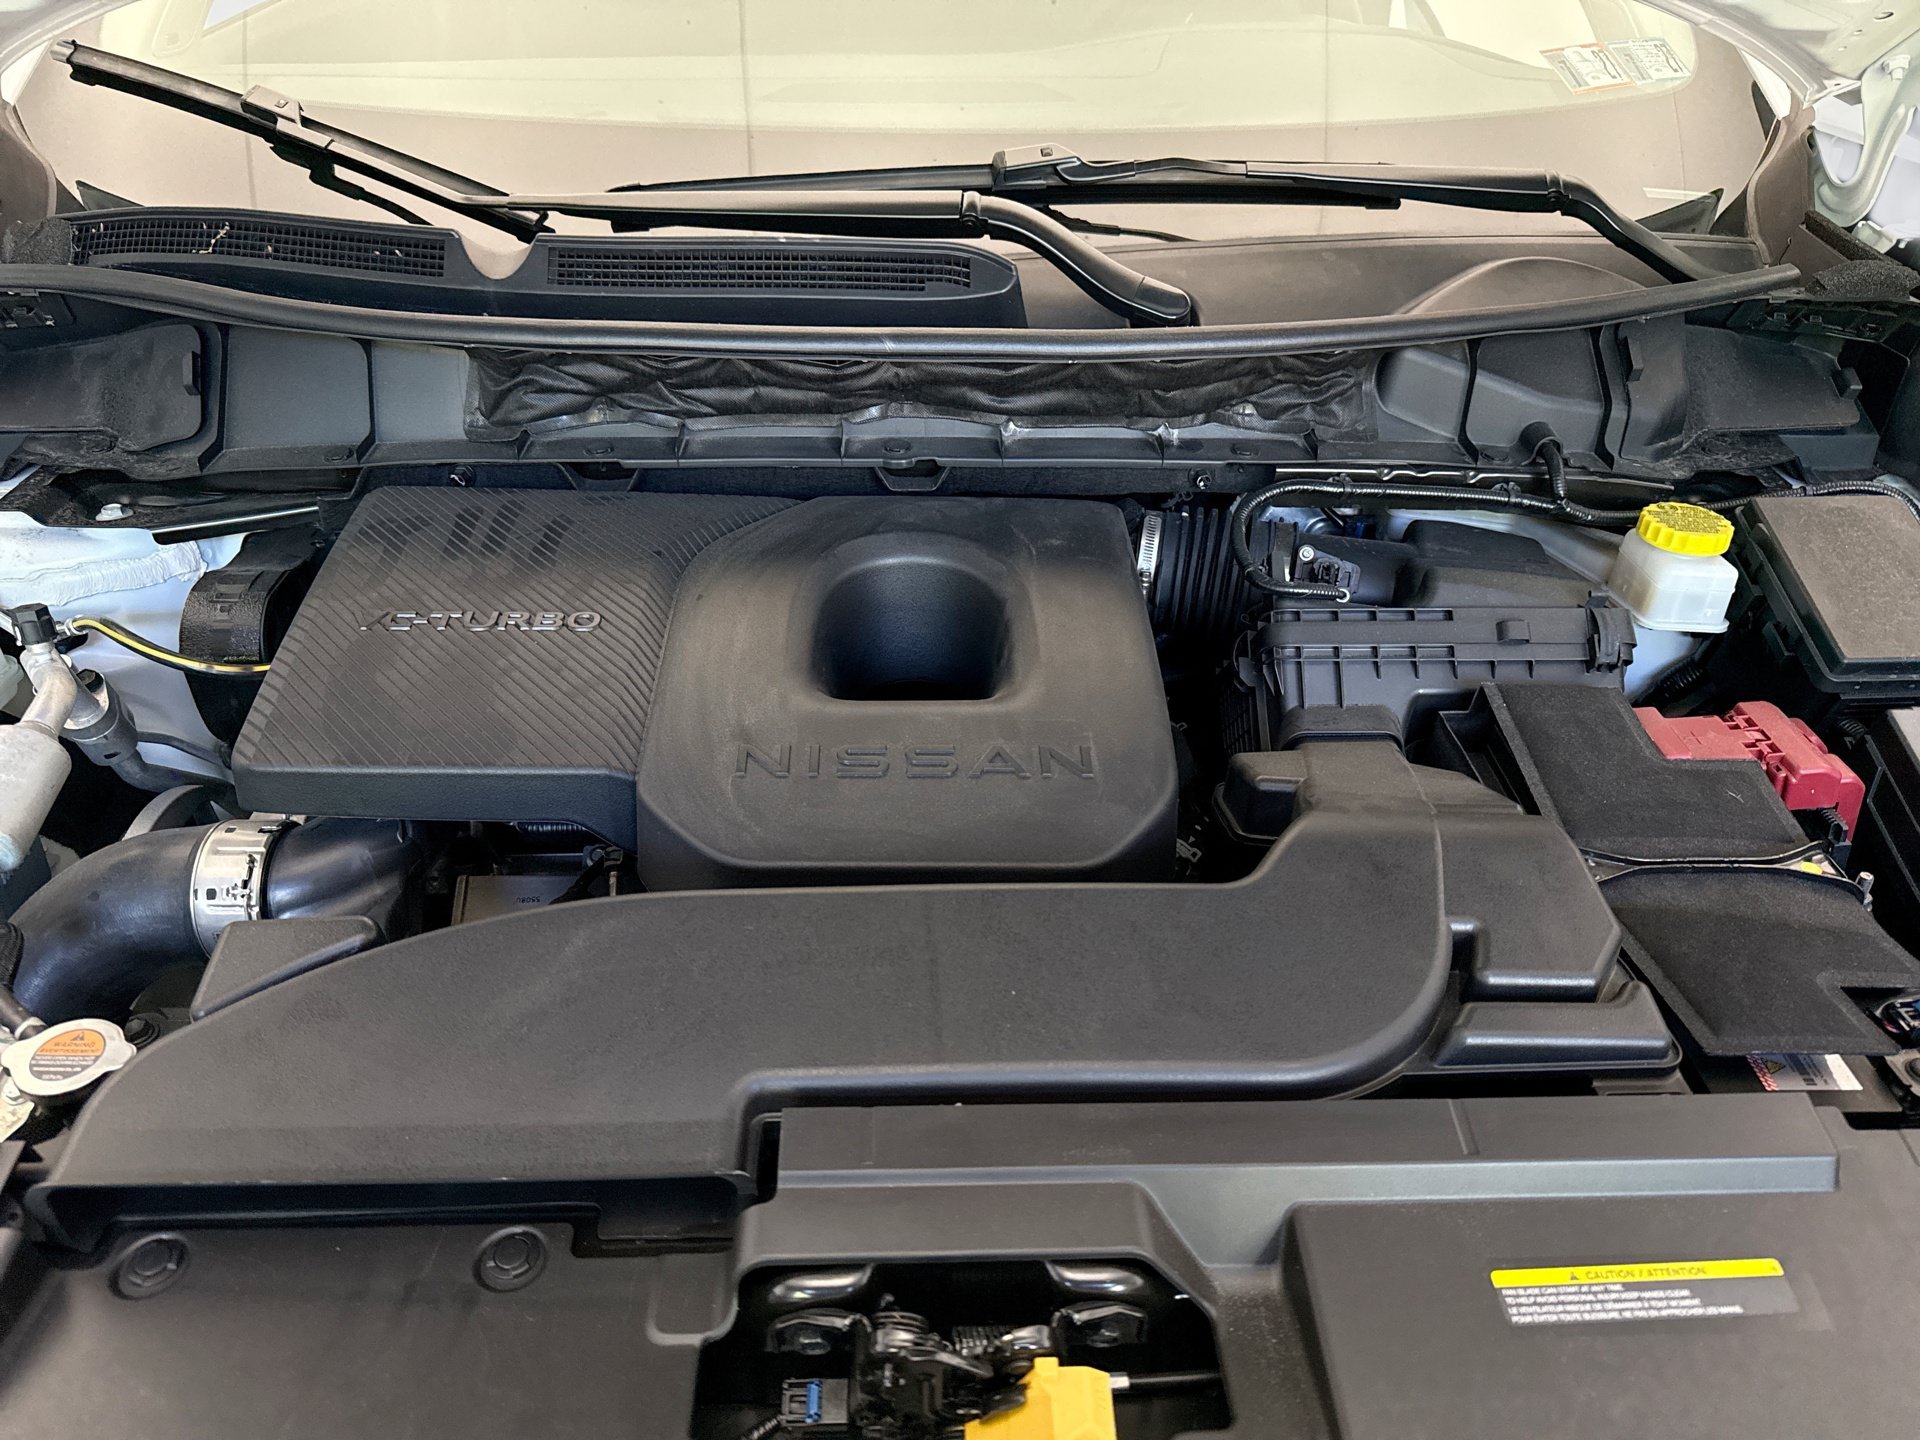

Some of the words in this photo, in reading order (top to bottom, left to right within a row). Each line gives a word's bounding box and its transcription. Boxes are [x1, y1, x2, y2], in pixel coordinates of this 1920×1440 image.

[356, 610, 603, 632] VC-TURBO
[735, 743, 1095, 779] NISSAN
[1586, 1267, 1633, 1280] CAUTION
[1647, 1265, 1707, 1277] ATTENTION
